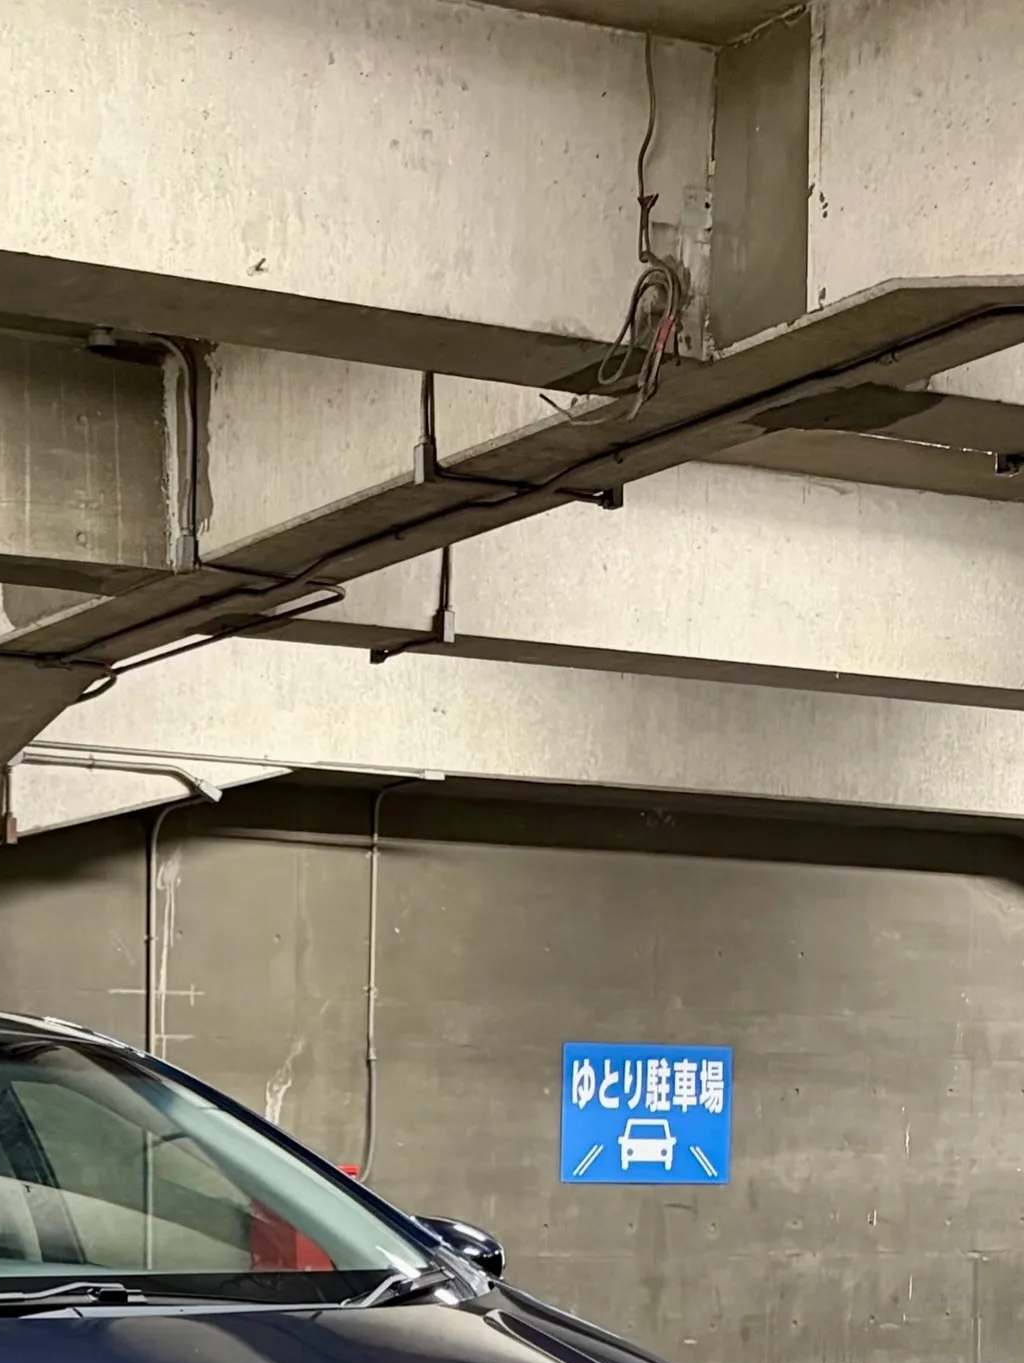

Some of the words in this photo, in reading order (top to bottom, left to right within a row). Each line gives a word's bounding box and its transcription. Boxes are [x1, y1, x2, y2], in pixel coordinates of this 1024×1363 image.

[572, 1058, 724, 1114] ゆとり駐車場
